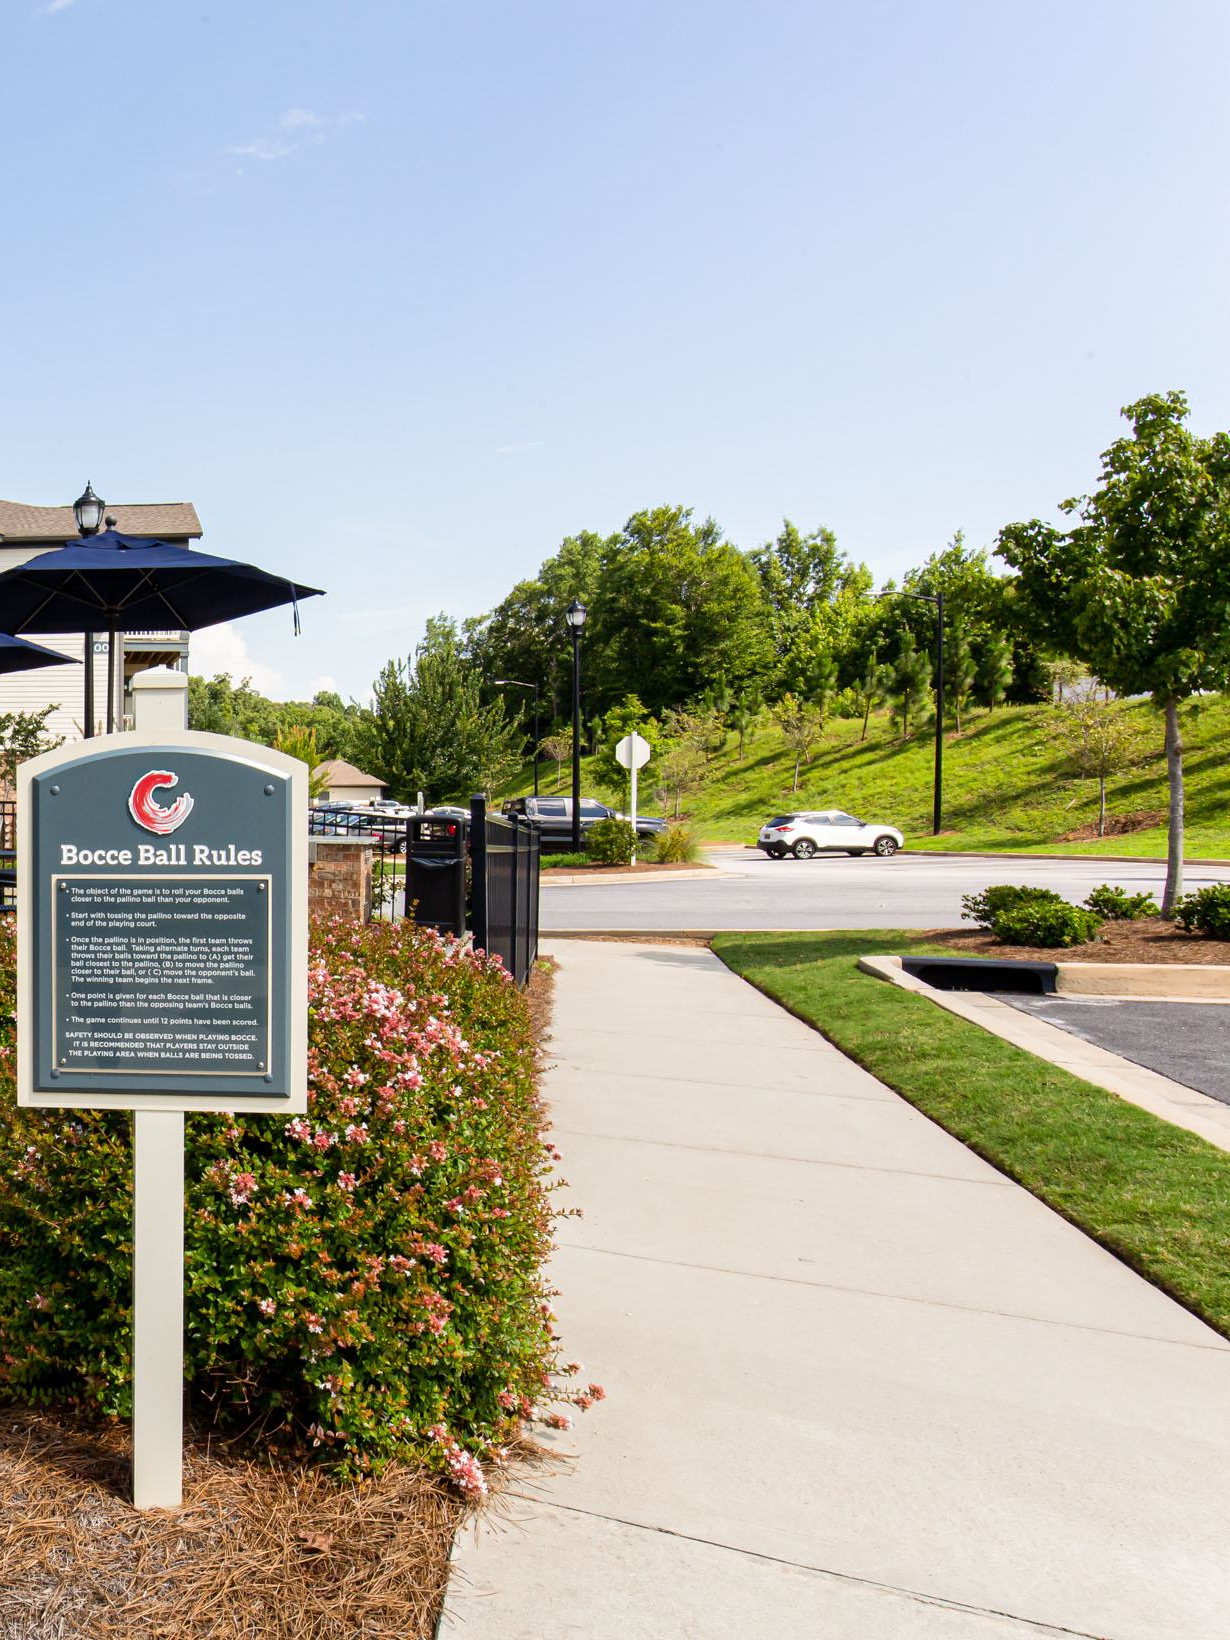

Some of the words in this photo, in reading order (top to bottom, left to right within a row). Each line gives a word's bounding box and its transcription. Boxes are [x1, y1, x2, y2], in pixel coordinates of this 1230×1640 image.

[60, 844, 132, 866] Bocce
[137, 844, 188, 866] Ball
[193, 844, 263, 866] Rules
[85, 887, 108, 896] object
[110, 887, 118, 895] of
[119, 887, 131, 895] the
[116, 895, 141, 904] pallino
[157, 895, 173, 903] than
[192, 896, 229, 904] opponent.
[71, 911, 88, 919] Start
[107, 912, 132, 920] tossing
[147, 912, 172, 921] pallino
[213, 912, 246, 921] opposite
[95, 919, 107, 927] the
[108, 919, 134, 928] playing
[104, 936, 128, 945] pallino
[137, 936, 144, 944] in
[146, 936, 177, 945] position,
[71, 943, 87, 951] their
[131, 944, 154, 953] Taking
[156, 944, 188, 952] alternate
[189, 945, 210, 953] turns,
[159, 952, 171, 960] the
[173, 952, 197, 961] pallino
[208, 953, 221, 961] (A)
[222, 953, 235, 962] get
[70, 959, 84, 967] ball
[134, 960, 160, 969] pallino,
[162, 960, 173, 969] (B)
[219, 961, 244, 970] pallino
[70, 967, 92, 975] closer
[121, 968, 136, 976] ball,
[184, 968, 196, 976] the
[198, 968, 238, 977] opponent's
[85, 975, 114, 984] winning
[134, 976, 159, 985] begins
[191, 976, 214, 984] frame.
[87, 992, 106, 1001] point
[115, 992, 134, 1001] given
[136, 992, 147, 1000] for
[148, 992, 165, 1000] each
[229, 993, 252, 1001] closer
[93, 1000, 117, 1009] pallino
[136, 1000, 148, 1008] the
[150, 1000, 183, 1009] opposing
[210, 1001, 233, 1009] Bocce
[234, 1001, 253, 1009] balls.
[107, 1016, 141, 1024] continues
[169, 1017, 192, 1026] points
[93, 1031, 122, 1039] SHOULD
[124, 1031, 133, 1039] BE
[175, 1032, 197, 1040] WHEN
[231, 1033, 258, 1041] BOCCE.
[89, 1040, 144, 1048] RECOMMENDED
[146, 1041, 164, 1049] THAT
[199, 1042, 216, 1050] STAY
[217, 1042, 249, 1050] OUTSIDE
[68, 1049, 82, 1057] THE
[115, 1050, 135, 1058] AREA
[136, 1050, 159, 1058] WHEN
[184, 1051, 199, 1059] ARE
[224, 1052, 254, 1060] TOSSED.
